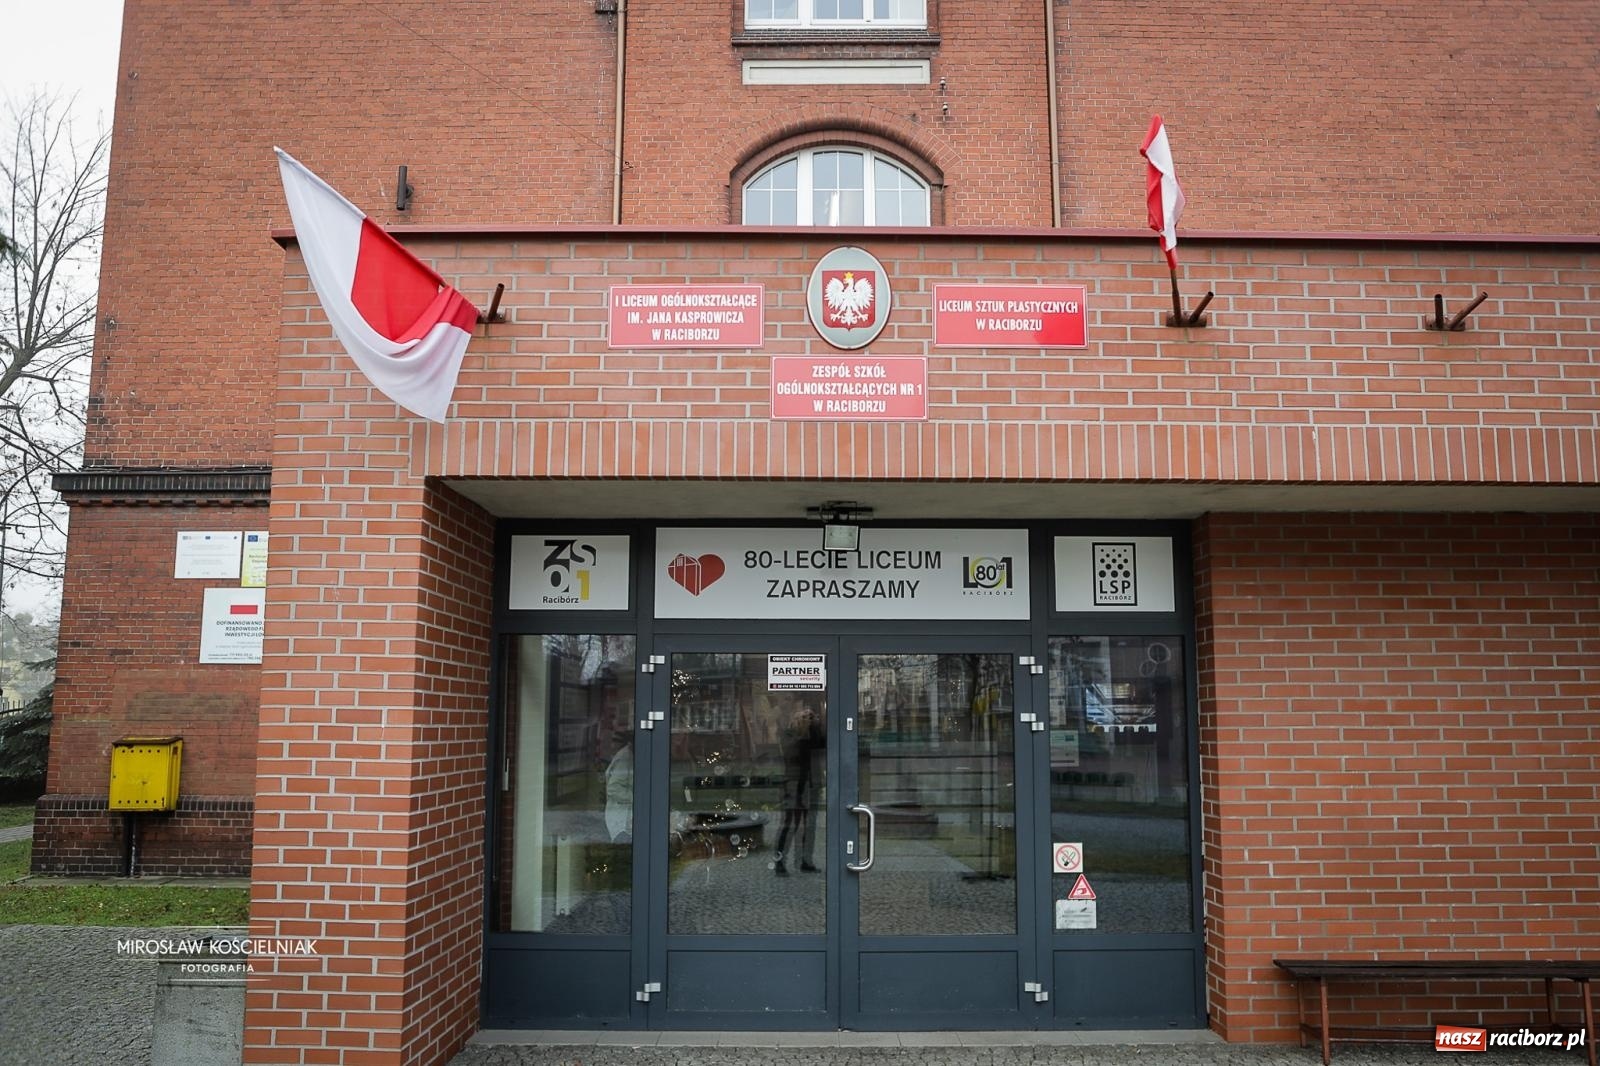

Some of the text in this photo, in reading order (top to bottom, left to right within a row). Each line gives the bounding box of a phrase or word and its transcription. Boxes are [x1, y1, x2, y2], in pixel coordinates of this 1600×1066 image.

[622, 295, 657, 307] LICEUM
[661, 292, 757, 309] OGÓLNOKSZTAŁCĄCE
[939, 300, 1078, 313] LICEUM SZTUK PLASTYCZNYCH
[627, 311, 744, 324] IM. JANA KASPROWICZA
[975, 318, 1042, 331] W RACIBORZU
[651, 328, 720, 340] W RACIBORZU
[811, 362, 886, 378] ZESPÓŁ SZKÓŁ
[776, 379, 922, 397] OGÓLNOKSZTAŁCĄCYCH NR 1
[813, 400, 886, 412] W RACIBORZU
[744, 550, 942, 569] 80-LECIE LICEUM
[976, 565, 997, 581] 80
[766, 579, 920, 599] ZAPRASZAMY
[1100, 580, 1131, 594] LSP
[542, 595, 579, 604] Racibórz
